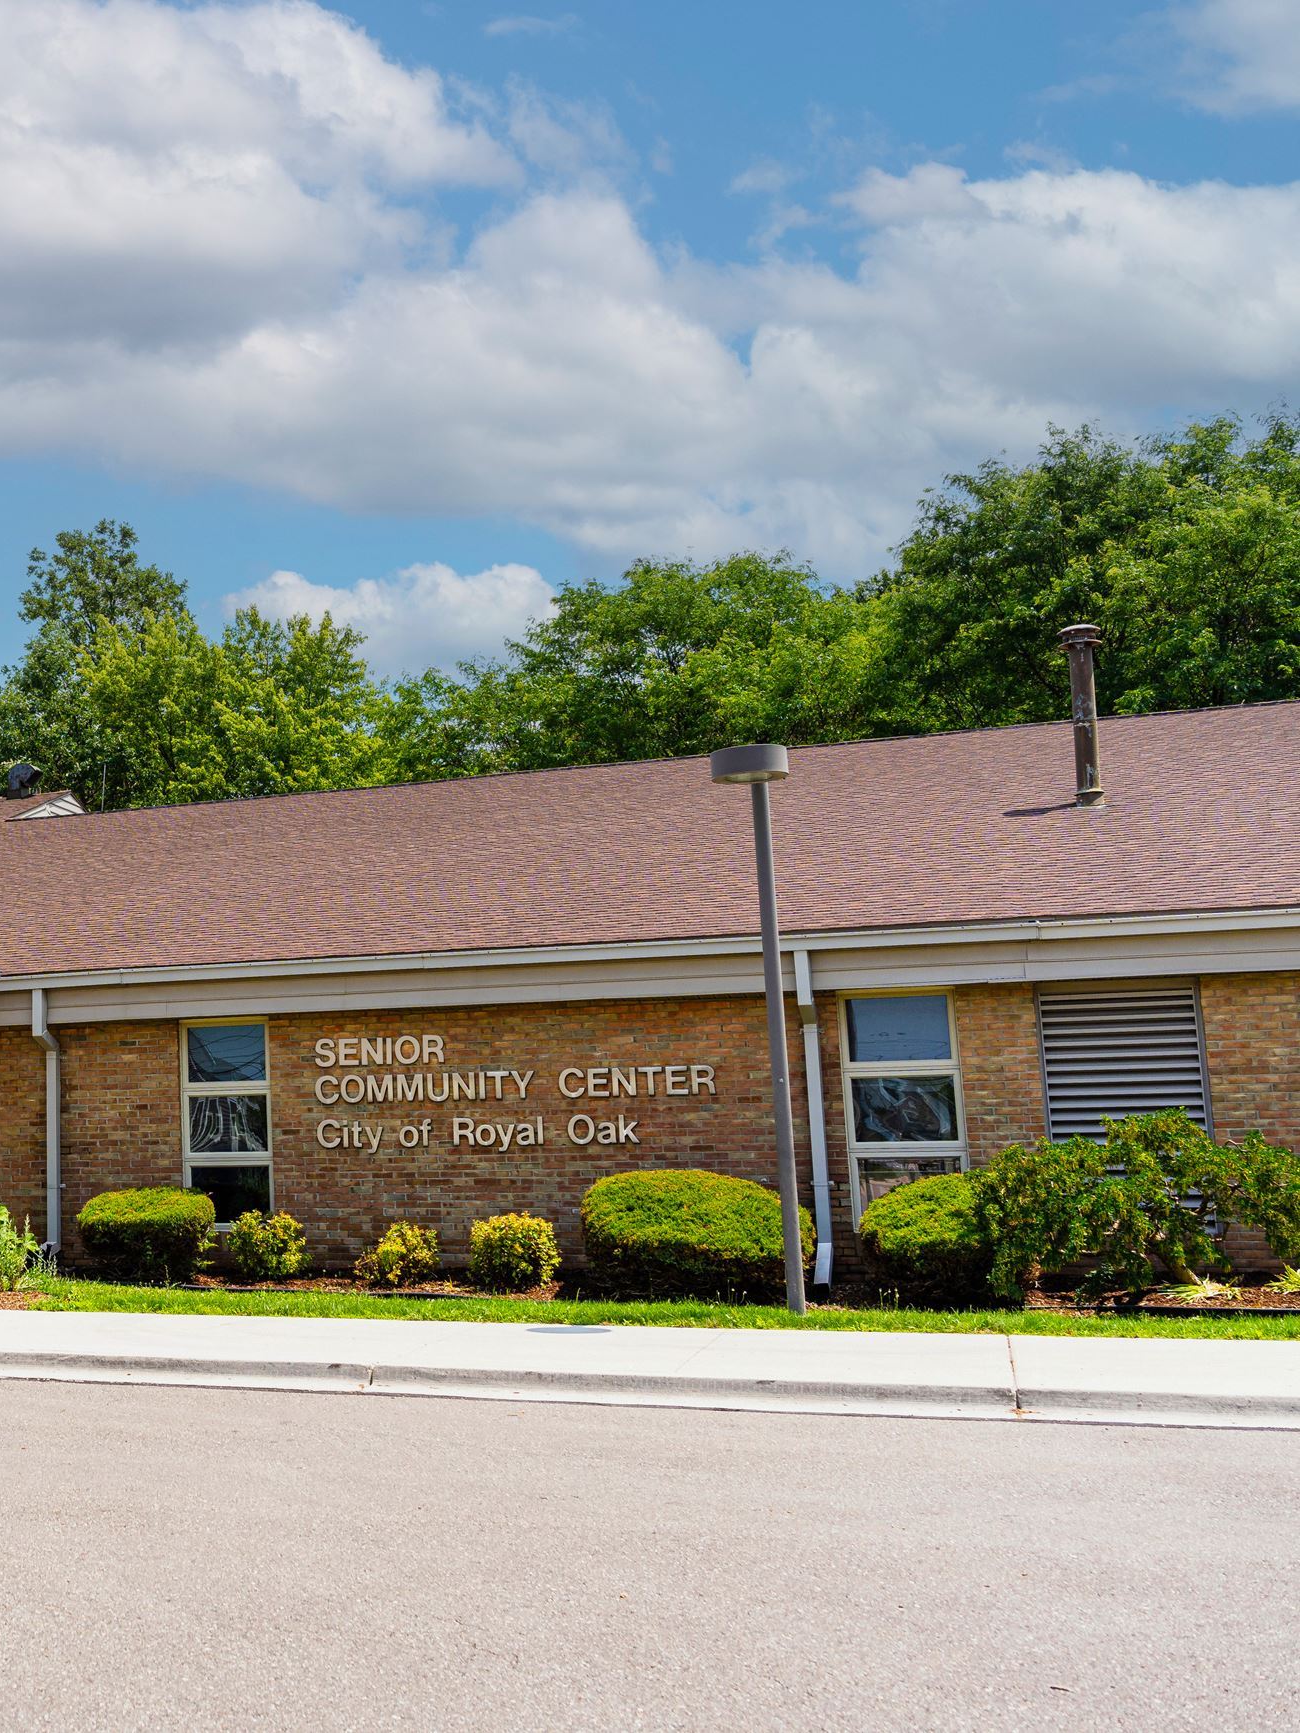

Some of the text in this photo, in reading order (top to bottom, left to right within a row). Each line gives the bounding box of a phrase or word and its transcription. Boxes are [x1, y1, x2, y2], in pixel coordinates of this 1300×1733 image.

[314, 1034, 446, 1068] SENIOR
[314, 1064, 718, 1105] COMMUNITY CENTER
[316, 1113, 642, 1154] City of Royal Oak
